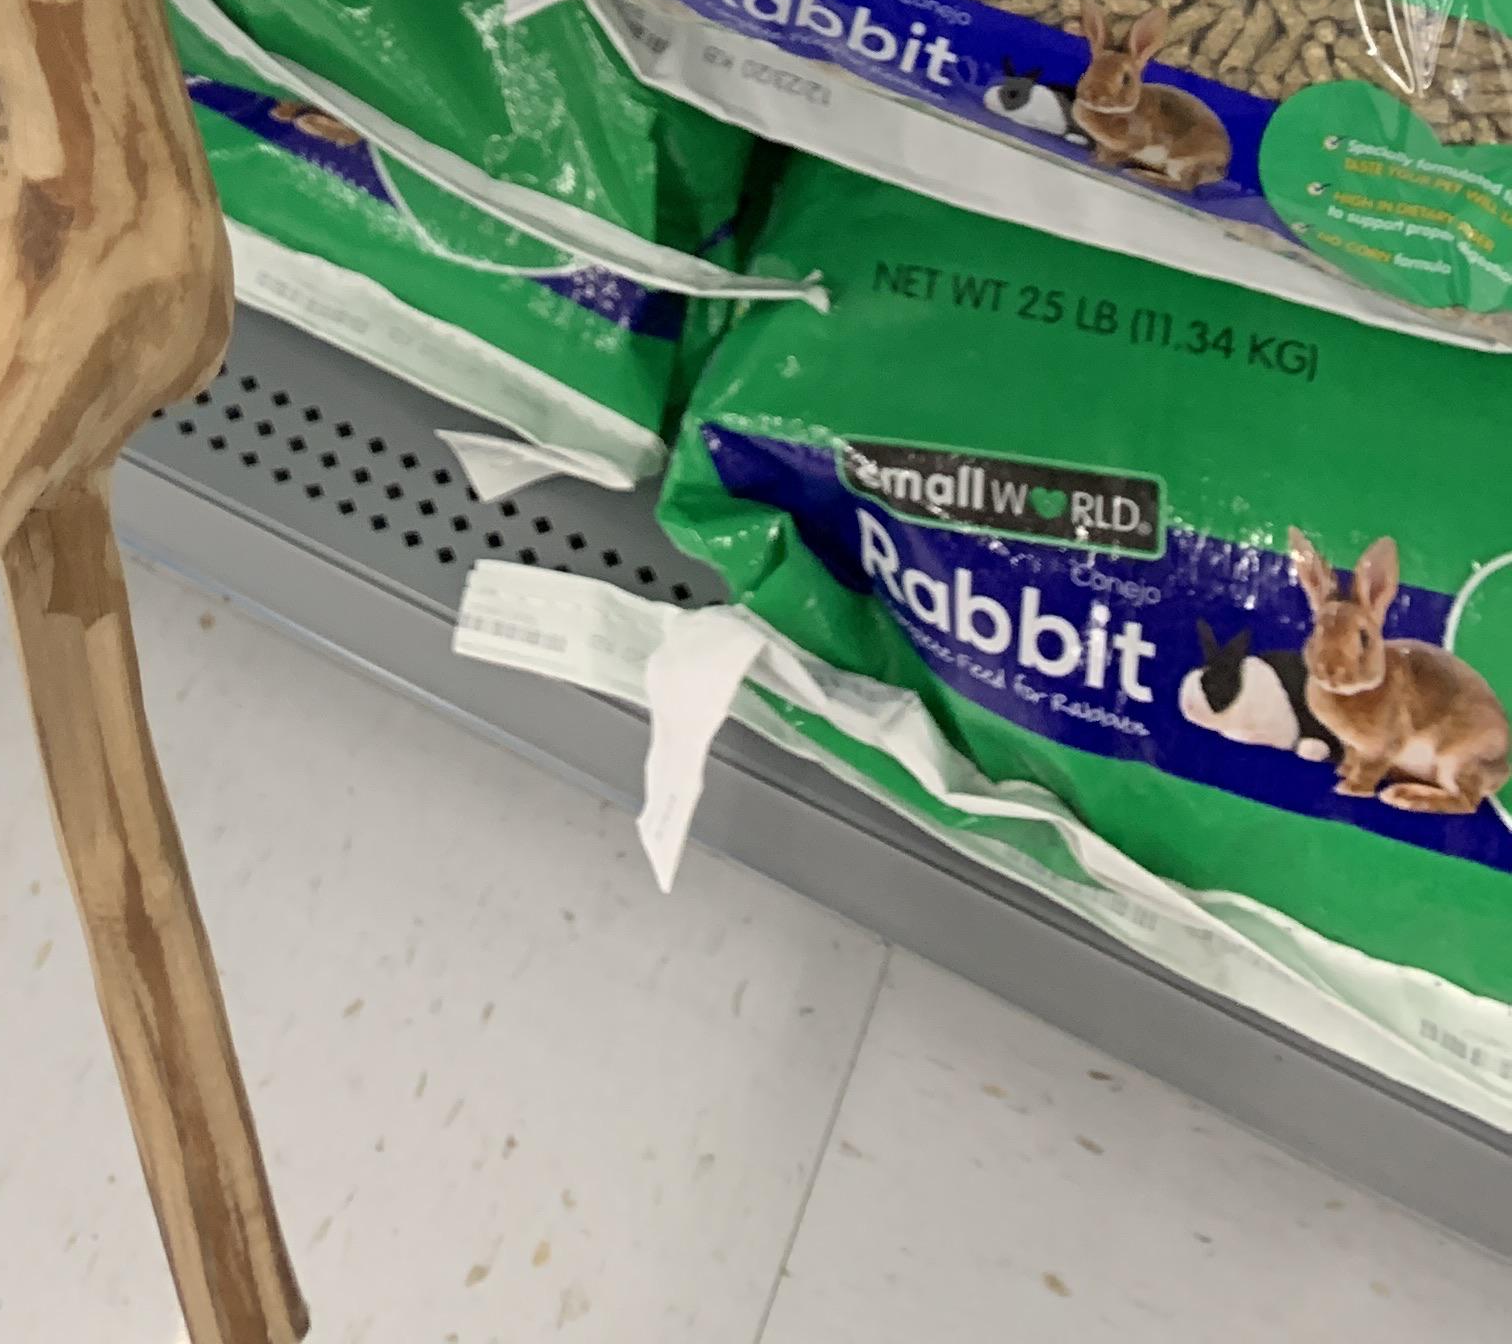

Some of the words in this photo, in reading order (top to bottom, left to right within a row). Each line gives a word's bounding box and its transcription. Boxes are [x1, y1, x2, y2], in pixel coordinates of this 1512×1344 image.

[1347, 139, 1414, 167] Specially
[1388, 165, 1432, 185] YOUR
[1433, 178, 1464, 193] PET
[1327, 204, 1344, 220] to
[1346, 211, 1405, 232] support
[1405, 223, 1456, 242] proper
[1393, 252, 1452, 275] formula
[872, 260, 942, 301] NET
[951, 272, 1010, 313] WT
[1017, 284, 1066, 324] 25
[1075, 296, 1120, 336] LB
[1129, 308, 1235, 360] (11.34
[1247, 333, 1319, 382] KG)
[1069, 561, 1162, 607] Conejo
[856, 507, 1157, 704] Rabbit
[1013, 673, 1049, 704] for
